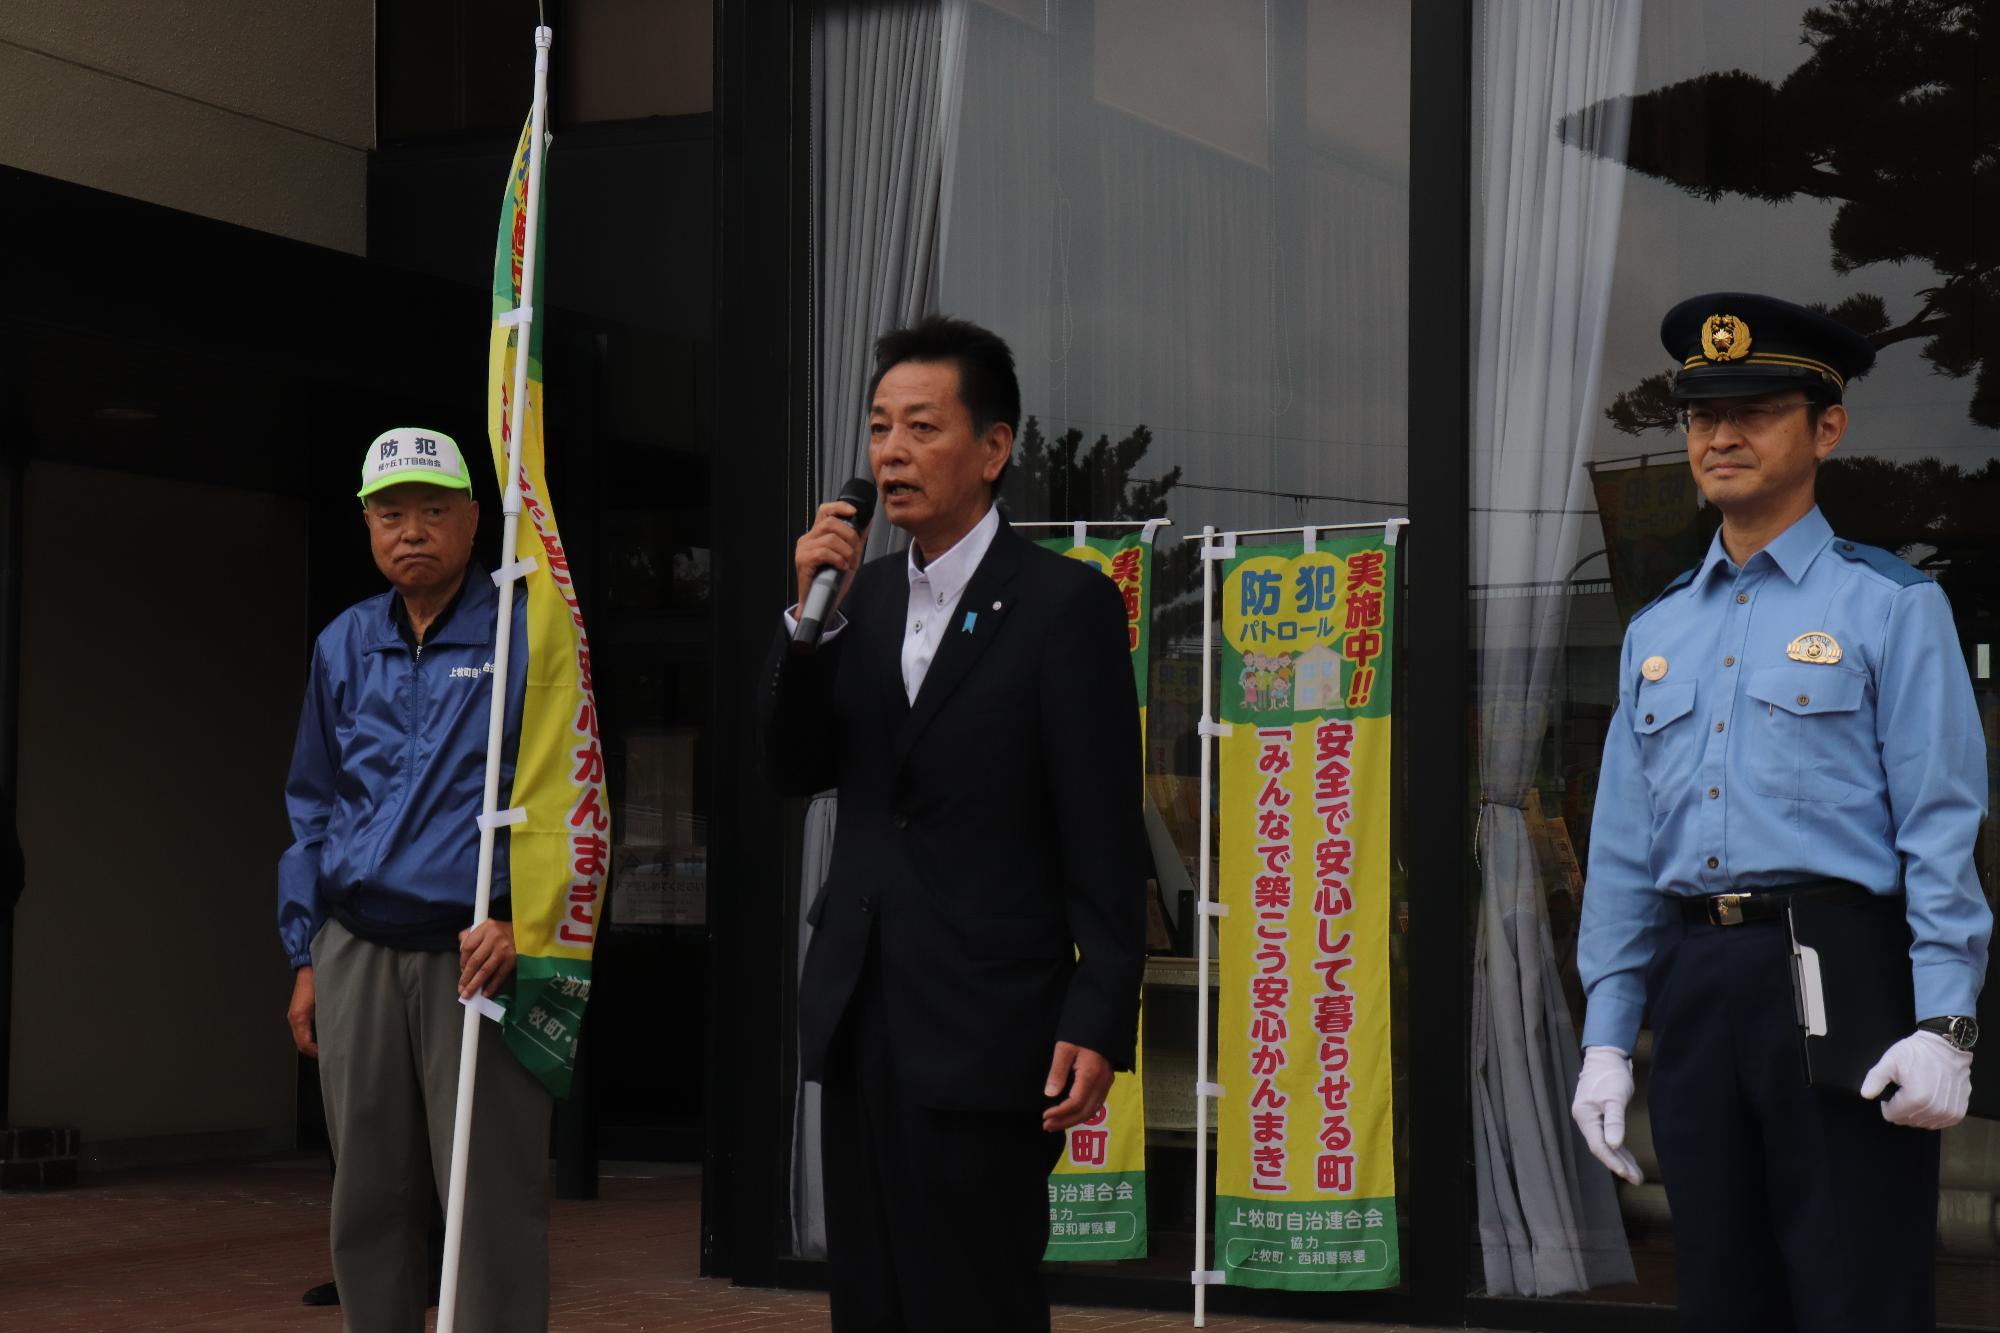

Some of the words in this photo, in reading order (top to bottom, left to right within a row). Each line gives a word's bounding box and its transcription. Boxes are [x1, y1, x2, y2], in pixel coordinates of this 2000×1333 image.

[1241, 565, 1336, 616] 防犯
[1239, 617, 1335, 643] パトロール
[1345, 553, 1384, 706] 実施中!!
[1250, 729, 1293, 1191] 「みんなで築こう安心かんまき」
[1313, 722, 1355, 1192] 安全で安心して暮らせる町
[1229, 1207, 1384, 1231] 上牧町自治連合会
[1248, 1248, 1366, 1265] 上牧町・西和警察署
[1290, 1235, 1319, 1250] 協力
